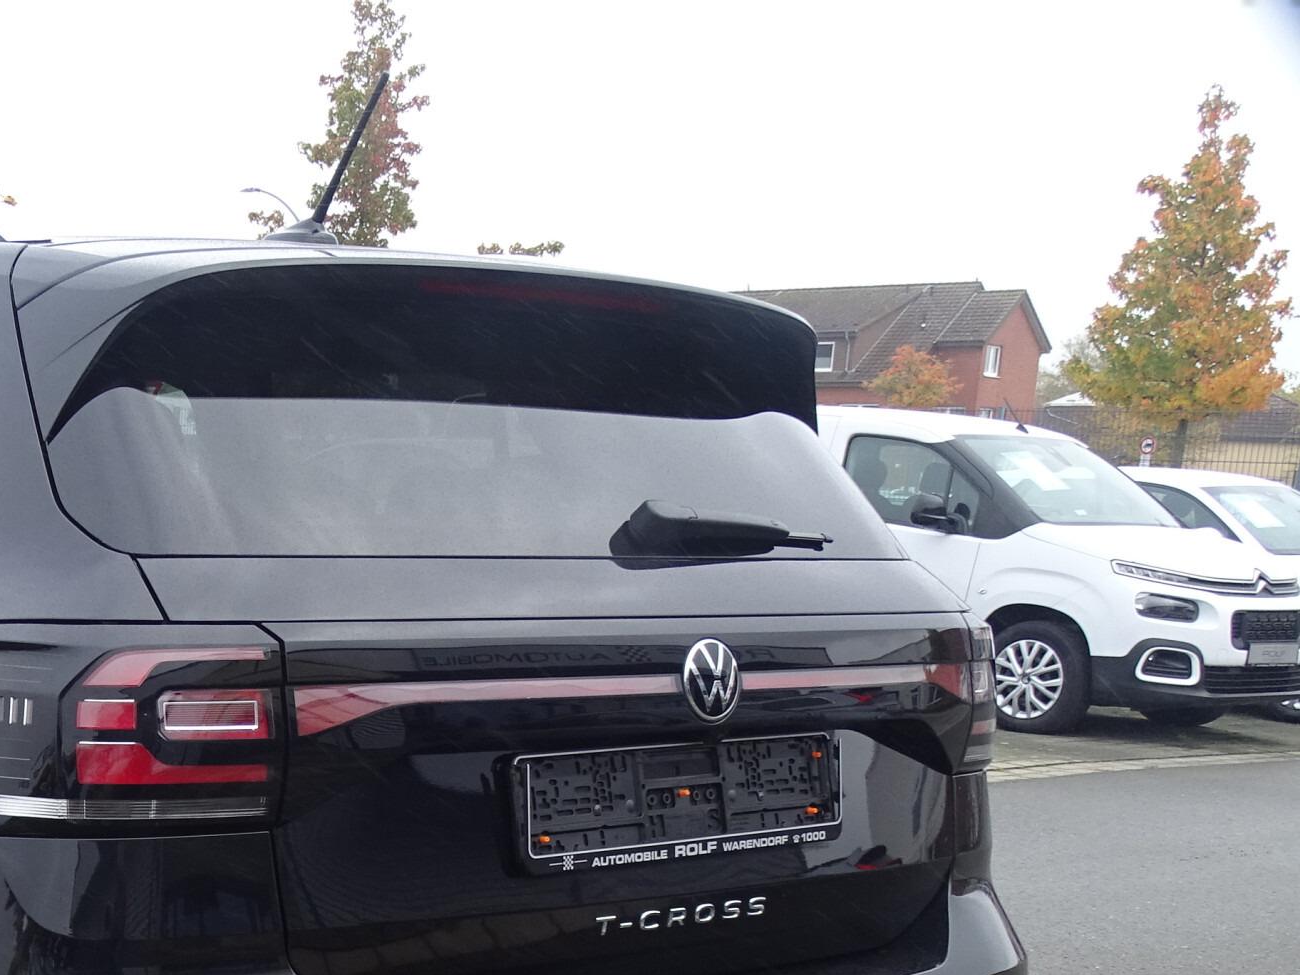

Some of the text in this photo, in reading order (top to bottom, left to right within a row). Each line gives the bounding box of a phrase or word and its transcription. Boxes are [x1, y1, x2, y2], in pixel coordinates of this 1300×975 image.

[592, 831, 826, 867] AUTOMOBILE ROLF WARENDORF 1000
[596, 896, 767, 936] T-CROSS
